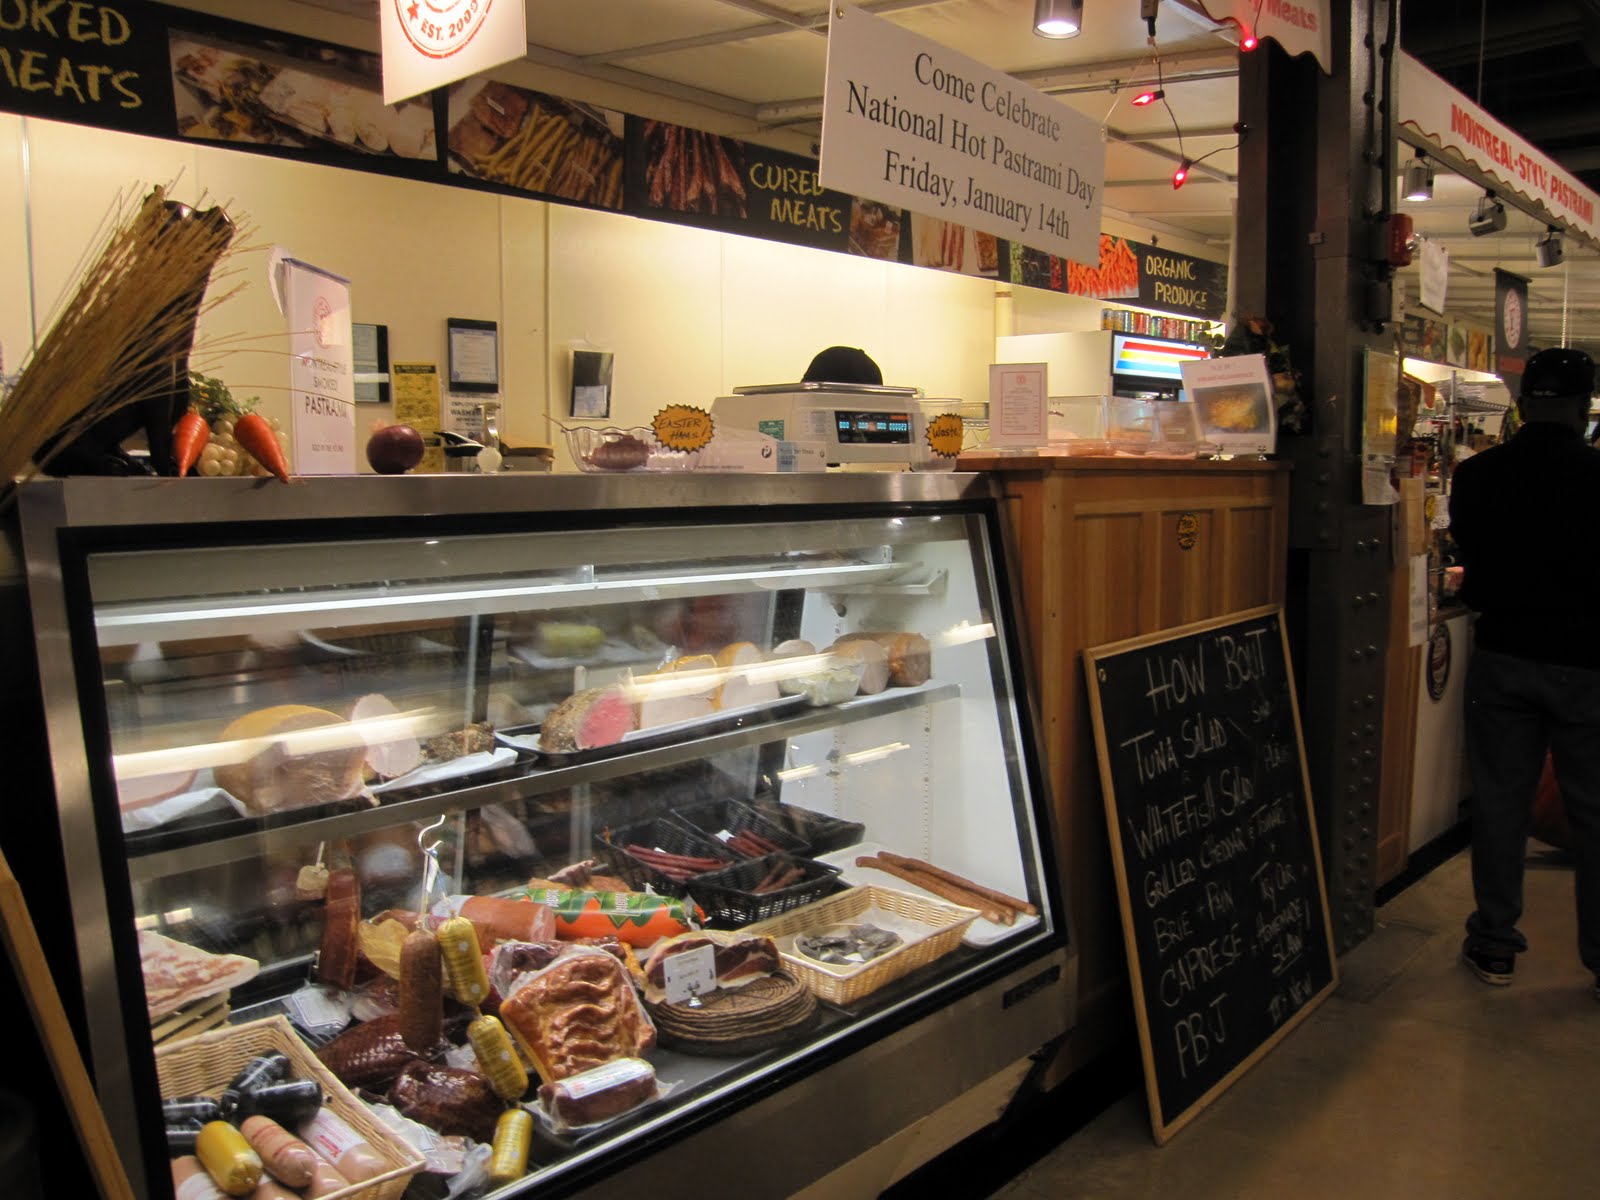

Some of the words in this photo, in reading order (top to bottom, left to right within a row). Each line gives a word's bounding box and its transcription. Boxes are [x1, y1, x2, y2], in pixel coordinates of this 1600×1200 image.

[421, 17, 444, 41] EST.
[449, 0, 479, 39] 2009
[915, 52, 975, 104] Come
[981, 81, 1060, 142] Celebrate
[846, 80, 944, 145] National
[951, 119, 986, 160] Hot
[992, 136, 1062, 190] Pastrami
[1066, 168, 1095, 209] Day
[749, 162, 825, 197] CURED
[883, 149, 957, 208] Friday,
[964, 177, 1032, 232] January
[1039, 203, 1070, 240] 14th
[770, 197, 842, 233] MEATS
[1145, 255, 1196, 281] ORGANIC
[1154, 281, 1208, 308] PRODUCE
[658, 416, 702, 430] EASTER
[1145, 641, 1206, 716] HOW
[1119, 729, 1180, 786] TUNA
[1144, 857, 1198, 909] GRILLED
[1152, 910, 1194, 953] BRIE
[1160, 922, 1242, 1008] CAPRESE
